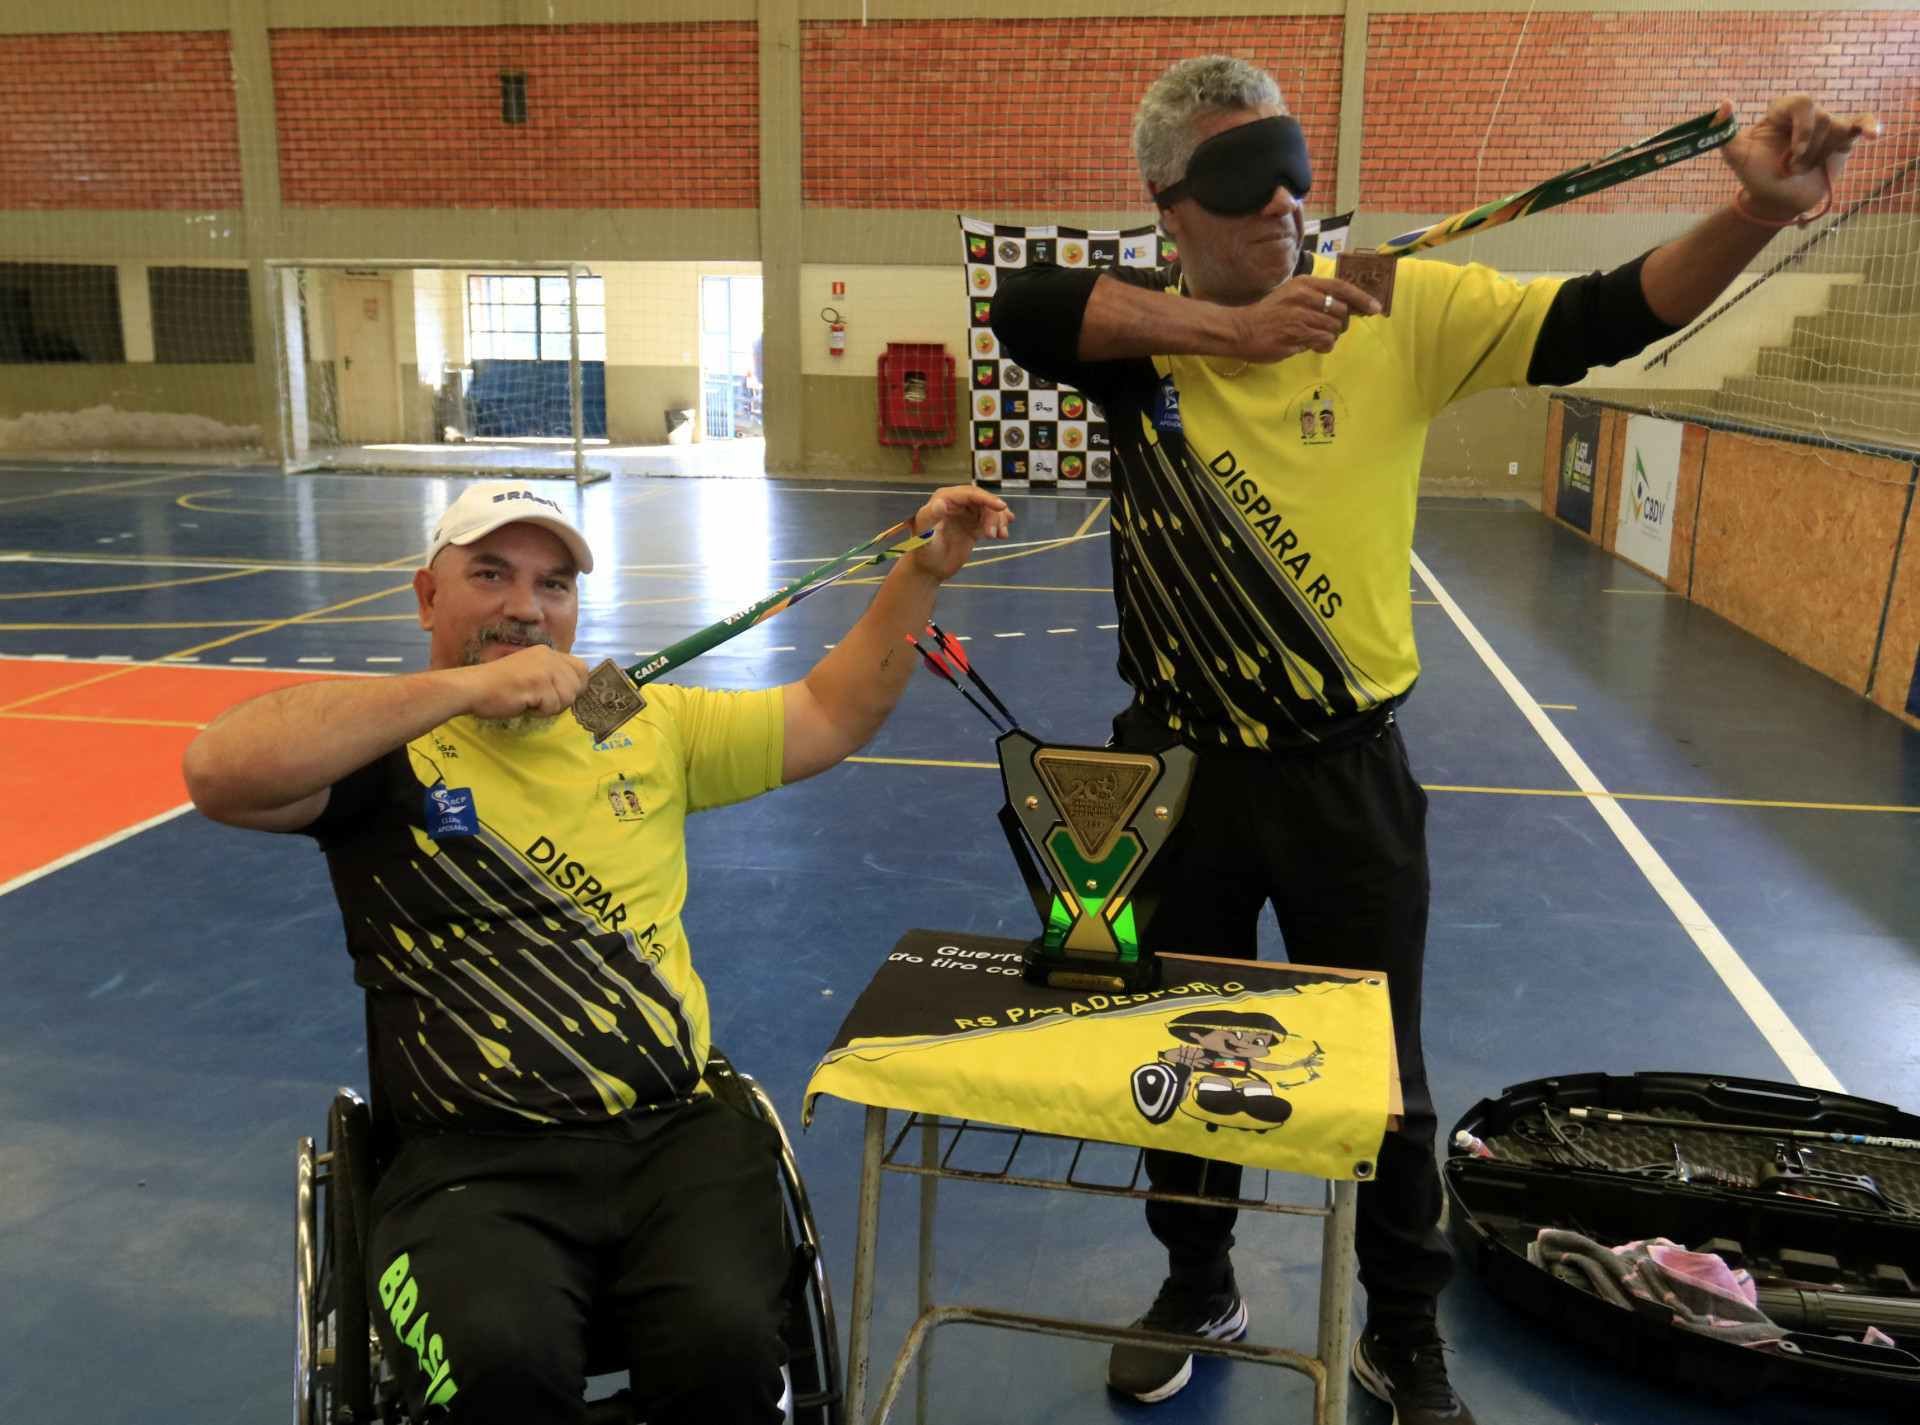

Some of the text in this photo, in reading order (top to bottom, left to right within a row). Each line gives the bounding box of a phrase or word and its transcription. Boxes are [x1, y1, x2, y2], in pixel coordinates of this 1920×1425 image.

[1643, 496, 1666, 526] CBDV
[1208, 449, 1343, 620] DISPARA RS
[634, 655, 669, 680] CAIXA
[525, 835, 627, 931] DISPAR
[888, 952, 1023, 977] do tiro co
[954, 1016, 998, 1031] RS
[378, 1251, 459, 1413] BRASIL
